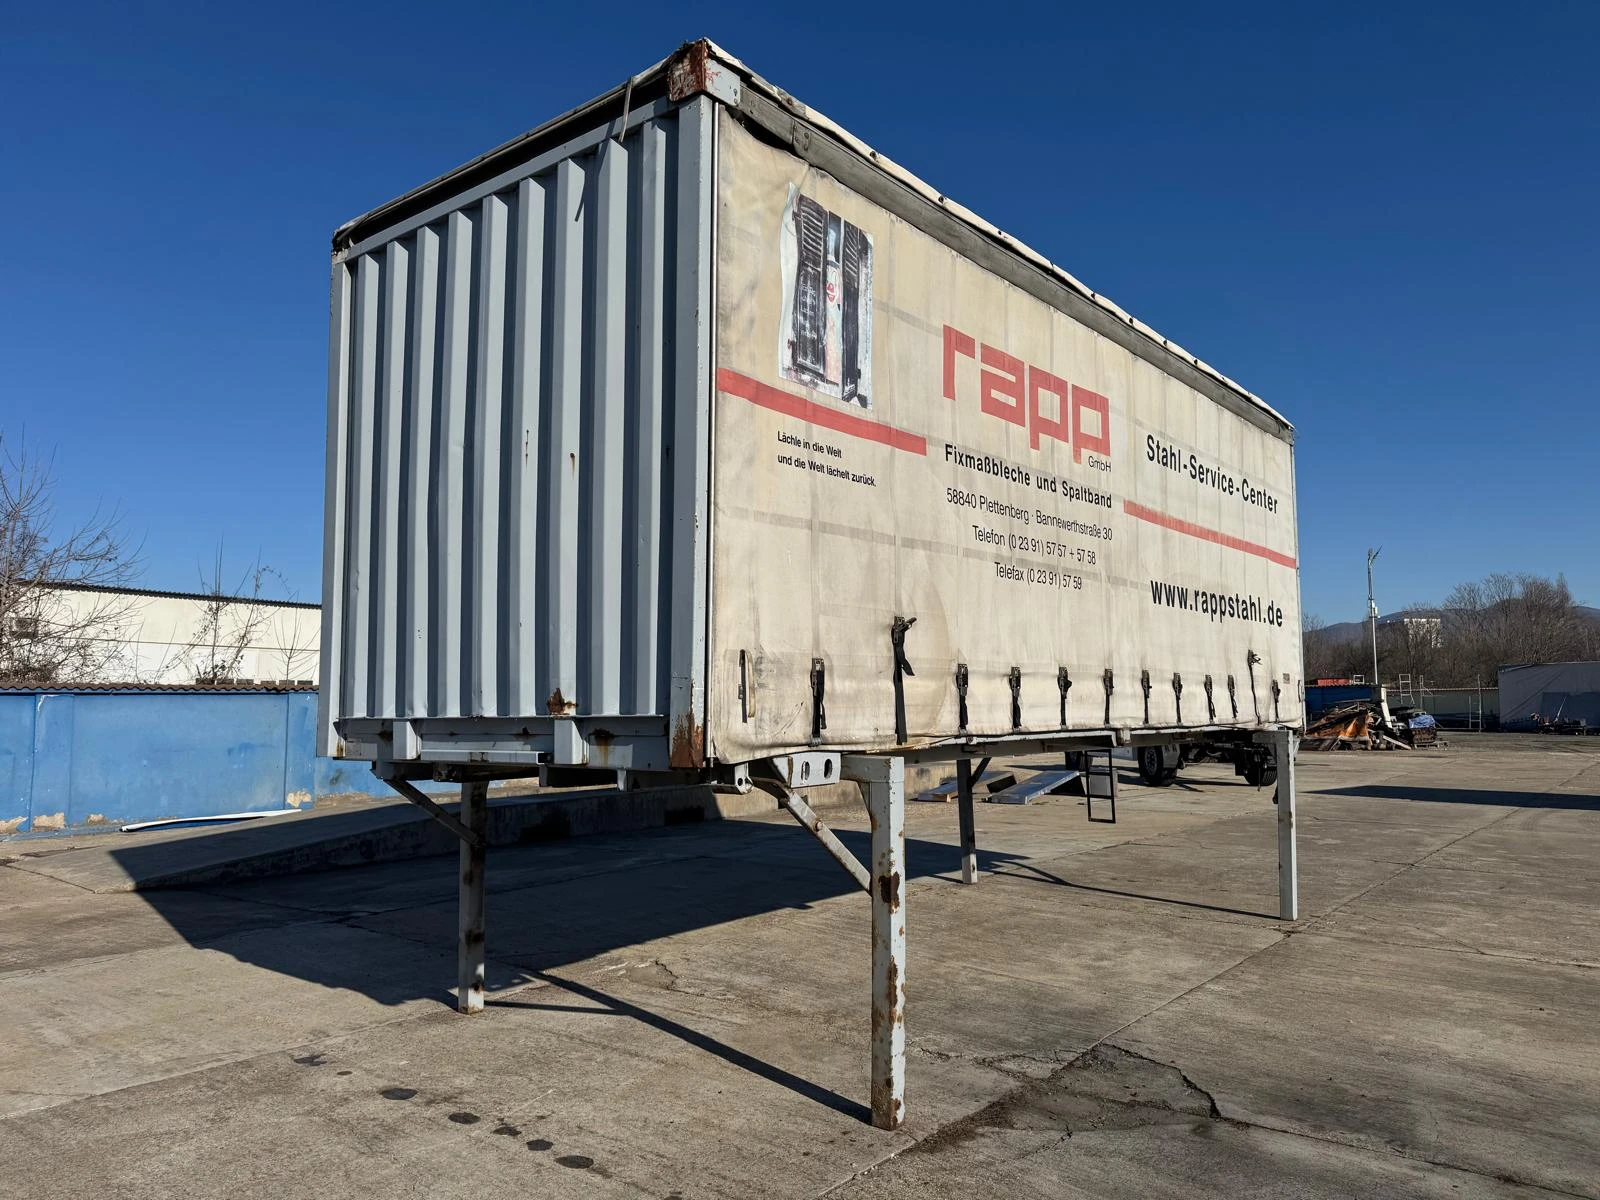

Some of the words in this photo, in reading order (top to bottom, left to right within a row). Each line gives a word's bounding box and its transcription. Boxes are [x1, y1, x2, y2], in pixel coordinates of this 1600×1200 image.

[943, 324, 1110, 464] rapp
[777, 431, 802, 447] Lächle
[803, 438, 811, 450] in
[812, 442, 825, 453] die
[825, 444, 842, 458] Welt
[1088, 455, 1112, 473] GmbH
[777, 454, 793, 466] und
[794, 457, 806, 470] die
[807, 460, 825, 474] Welt
[826, 464, 850, 480] lächelt
[851, 473, 877, 487] zurück.
[945, 443, 1030, 486] Fixmaßbleche
[1036, 475, 1057, 493] und
[1061, 480, 1112, 509] Spaltband
[1146, 434, 1278, 514] Stahl-Service-Center
[946, 488, 977, 509] 58840
[979, 495, 1029, 525] Plettenberg
[1036, 510, 1101, 539] Bannewerthstraße
[1102, 527, 1113, 541] 30
[972, 525, 1006, 547] Telefon
[1008, 532, 1017, 551] (0
[1018, 535, 1029, 551] 23
[1031, 538, 1044, 557] 91)
[1087, 550, 1096, 565] 58
[994, 562, 1025, 581] Telefax
[1026, 567, 1035, 585] (0
[1036, 569, 1047, 585] 23
[1048, 571, 1061, 589] 91)
[1073, 576, 1083, 590] 59
[1151, 580, 1283, 627] www.rappstahl.de
